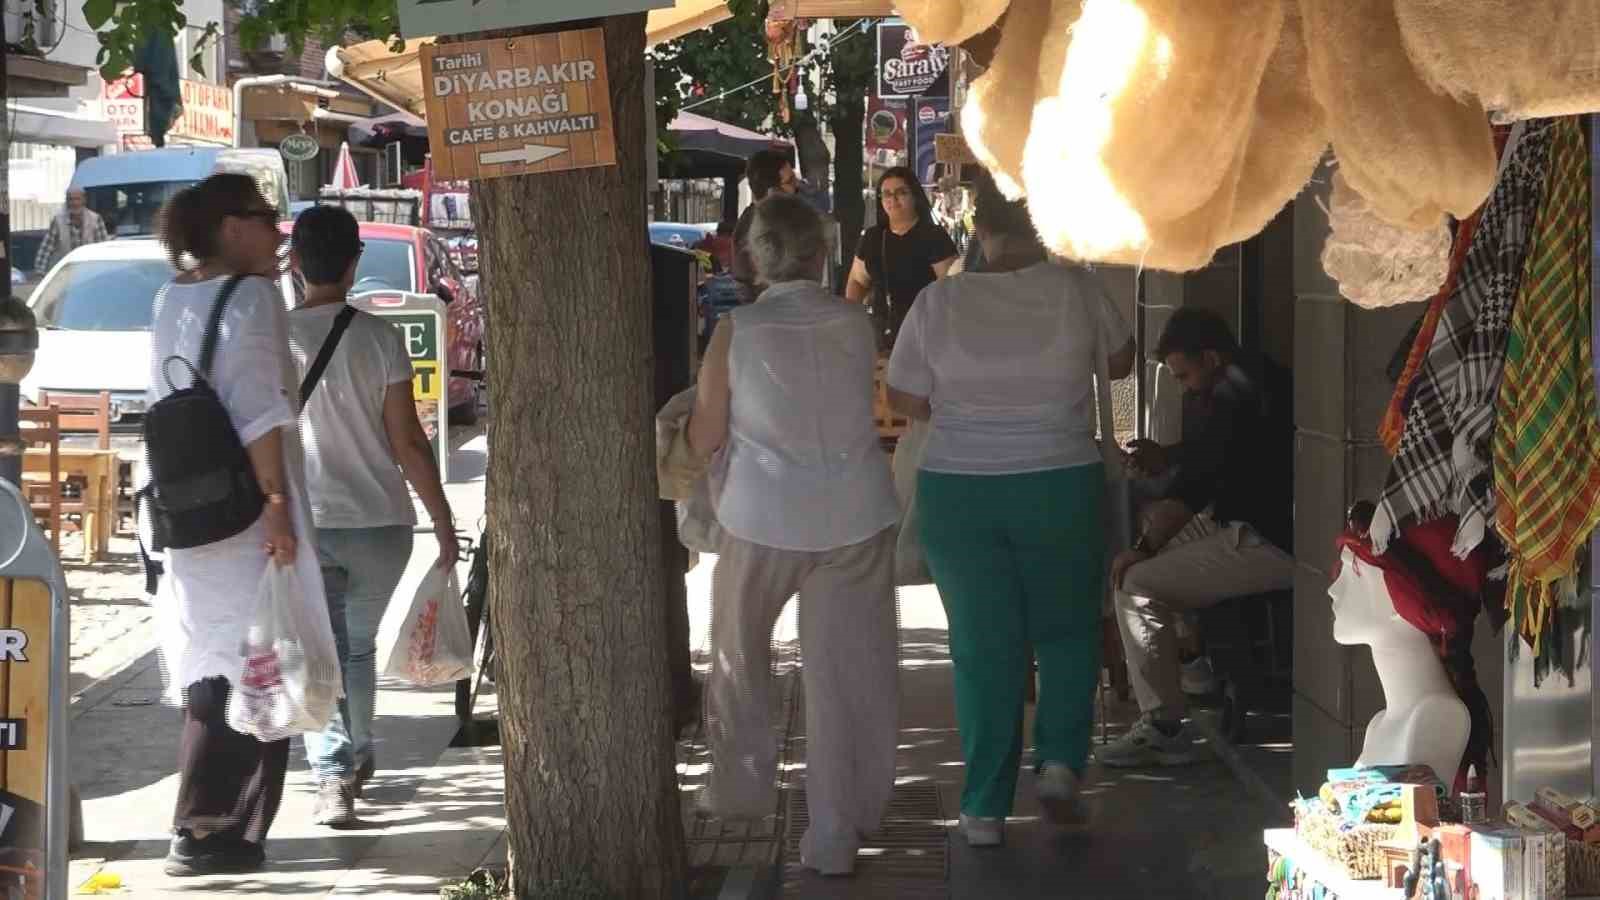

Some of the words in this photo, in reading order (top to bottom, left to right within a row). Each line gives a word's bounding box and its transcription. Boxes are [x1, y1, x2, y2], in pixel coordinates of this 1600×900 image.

[436, 53, 482, 70] Tarihi
[434, 60, 596, 97] DİYARBAKIR
[913, 77, 935, 87] FOOD
[107, 104, 137, 115] OTO
[468, 88, 568, 121] KONAĞI
[449, 127, 494, 144] CAFE
[498, 126, 511, 138] &
[513, 116, 595, 138] KAHVALTI
